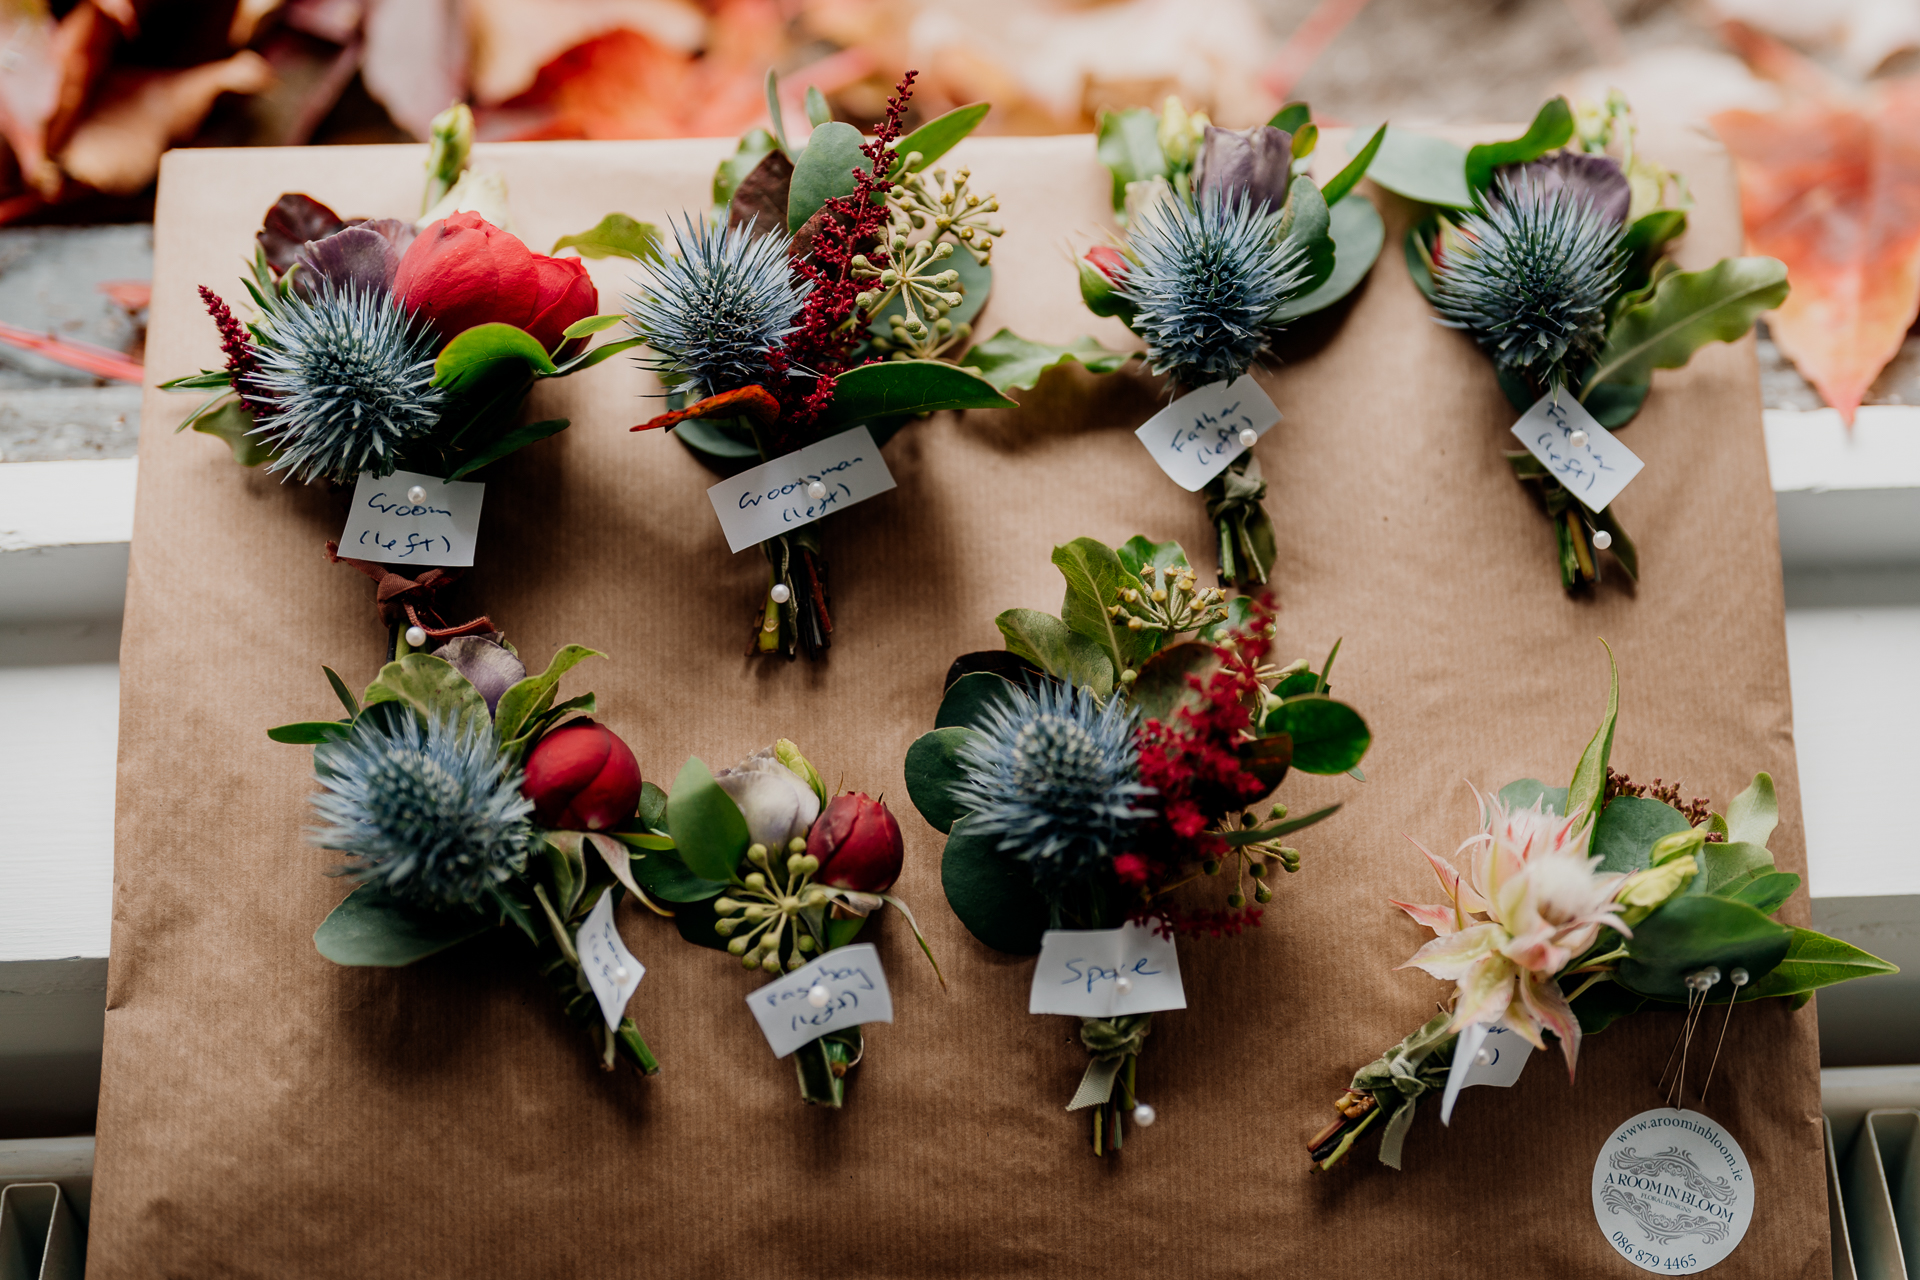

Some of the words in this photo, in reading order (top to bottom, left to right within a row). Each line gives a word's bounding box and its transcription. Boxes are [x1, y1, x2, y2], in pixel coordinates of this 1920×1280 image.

[1546, 401, 1616, 472] Faher
[367, 492, 452, 517] Groom
[359, 529, 451, 558] (left)
[1616, 1117, 1743, 1182] www.aroominbloom.ie
[1604, 1172, 1614, 1184] A
[1617, 1173, 1662, 1194] ROOM
[1664, 1184, 1681, 1200] IN
[1681, 1191, 1734, 1223] BLOOM
[1640, 1192, 1666, 1207] FLORAL
[1665, 1199, 1692, 1214] DESIGNS
[1612, 1230, 1636, 1255] 086
[1635, 1249, 1660, 1268] 879
[1663, 1253, 1697, 1270] 4465
